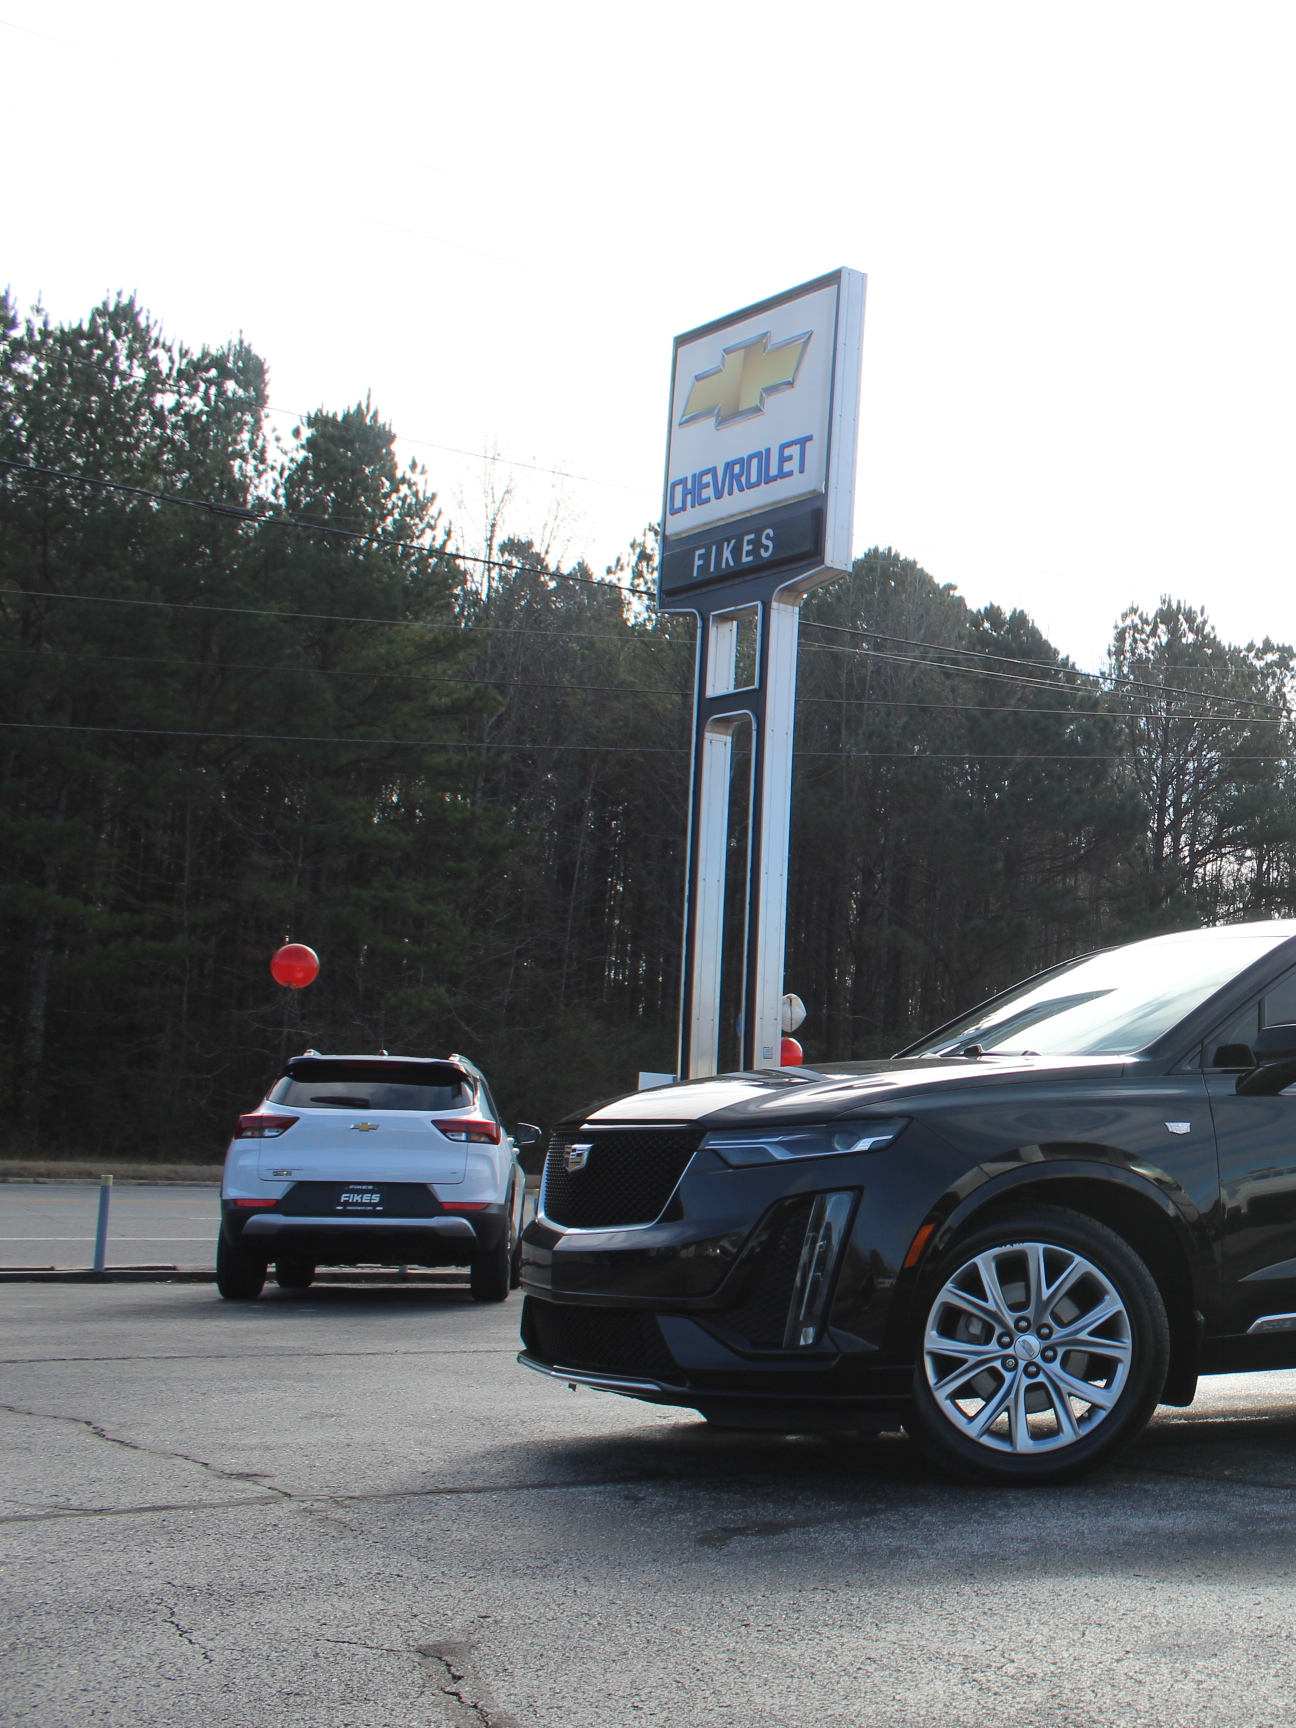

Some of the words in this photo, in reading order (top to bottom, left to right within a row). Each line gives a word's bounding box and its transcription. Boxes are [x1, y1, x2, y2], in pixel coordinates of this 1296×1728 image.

[669, 434, 813, 515] CHEVROLET
[693, 528, 774, 577] FIKES
[340, 1193, 381, 1203] FIKES
